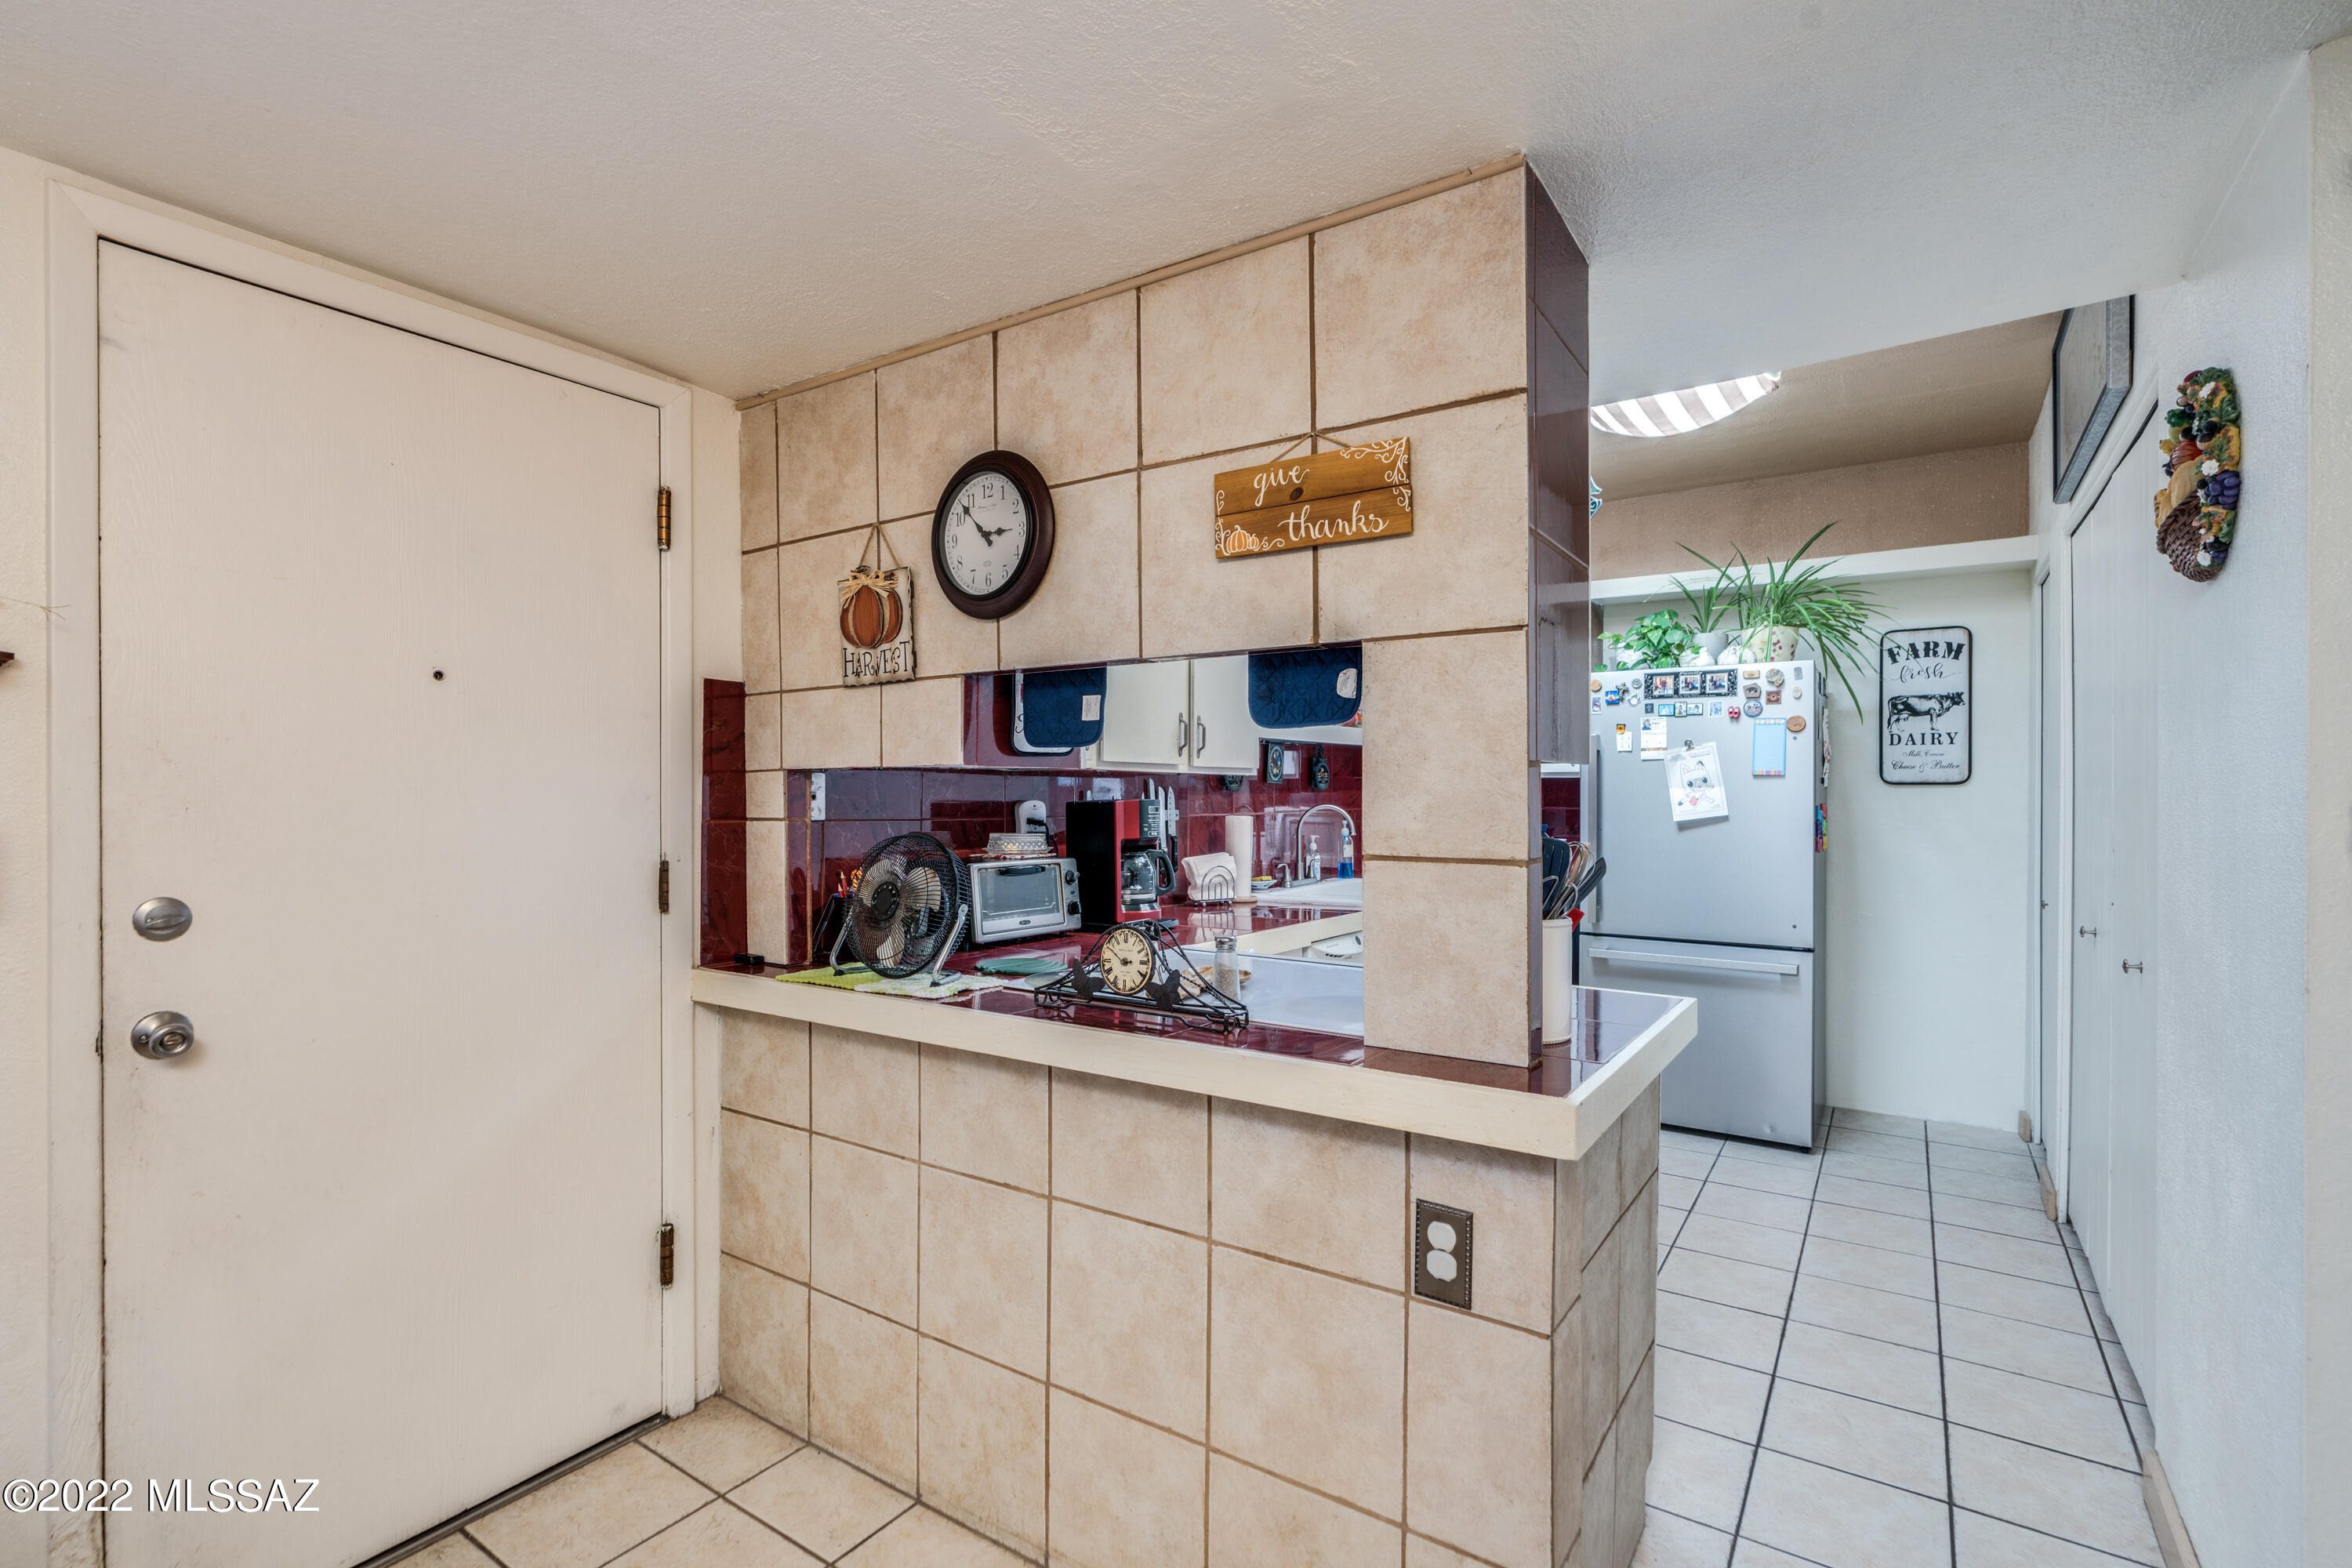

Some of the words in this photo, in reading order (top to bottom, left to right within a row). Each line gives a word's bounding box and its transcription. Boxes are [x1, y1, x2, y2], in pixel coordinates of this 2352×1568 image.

[982, 483, 993, 499] 12
[1000, 485, 1005, 500] 1
[1254, 465, 1309, 507] give
[967, 493, 975, 508] 11
[1012, 499, 1019, 514] 2
[956, 511, 965, 527] 10
[1277, 500, 1389, 542] thanks
[1019, 521, 1025, 537] 3
[952, 534, 957, 549] 9
[1014, 545, 1020, 560] 4
[956, 555, 963, 570] 8
[971, 569, 976, 584] 7
[1002, 564, 1008, 579] 5
[985, 572, 992, 587] 6
[843, 640, 909, 677] HARVEST
[1887, 641, 1965, 664] FARM
[1893, 662, 1954, 683] fresh
[1889, 731, 1959, 746] DAIRY
[1891, 760, 1916, 770] Cheese
[1930, 760, 1960, 770] Butter
